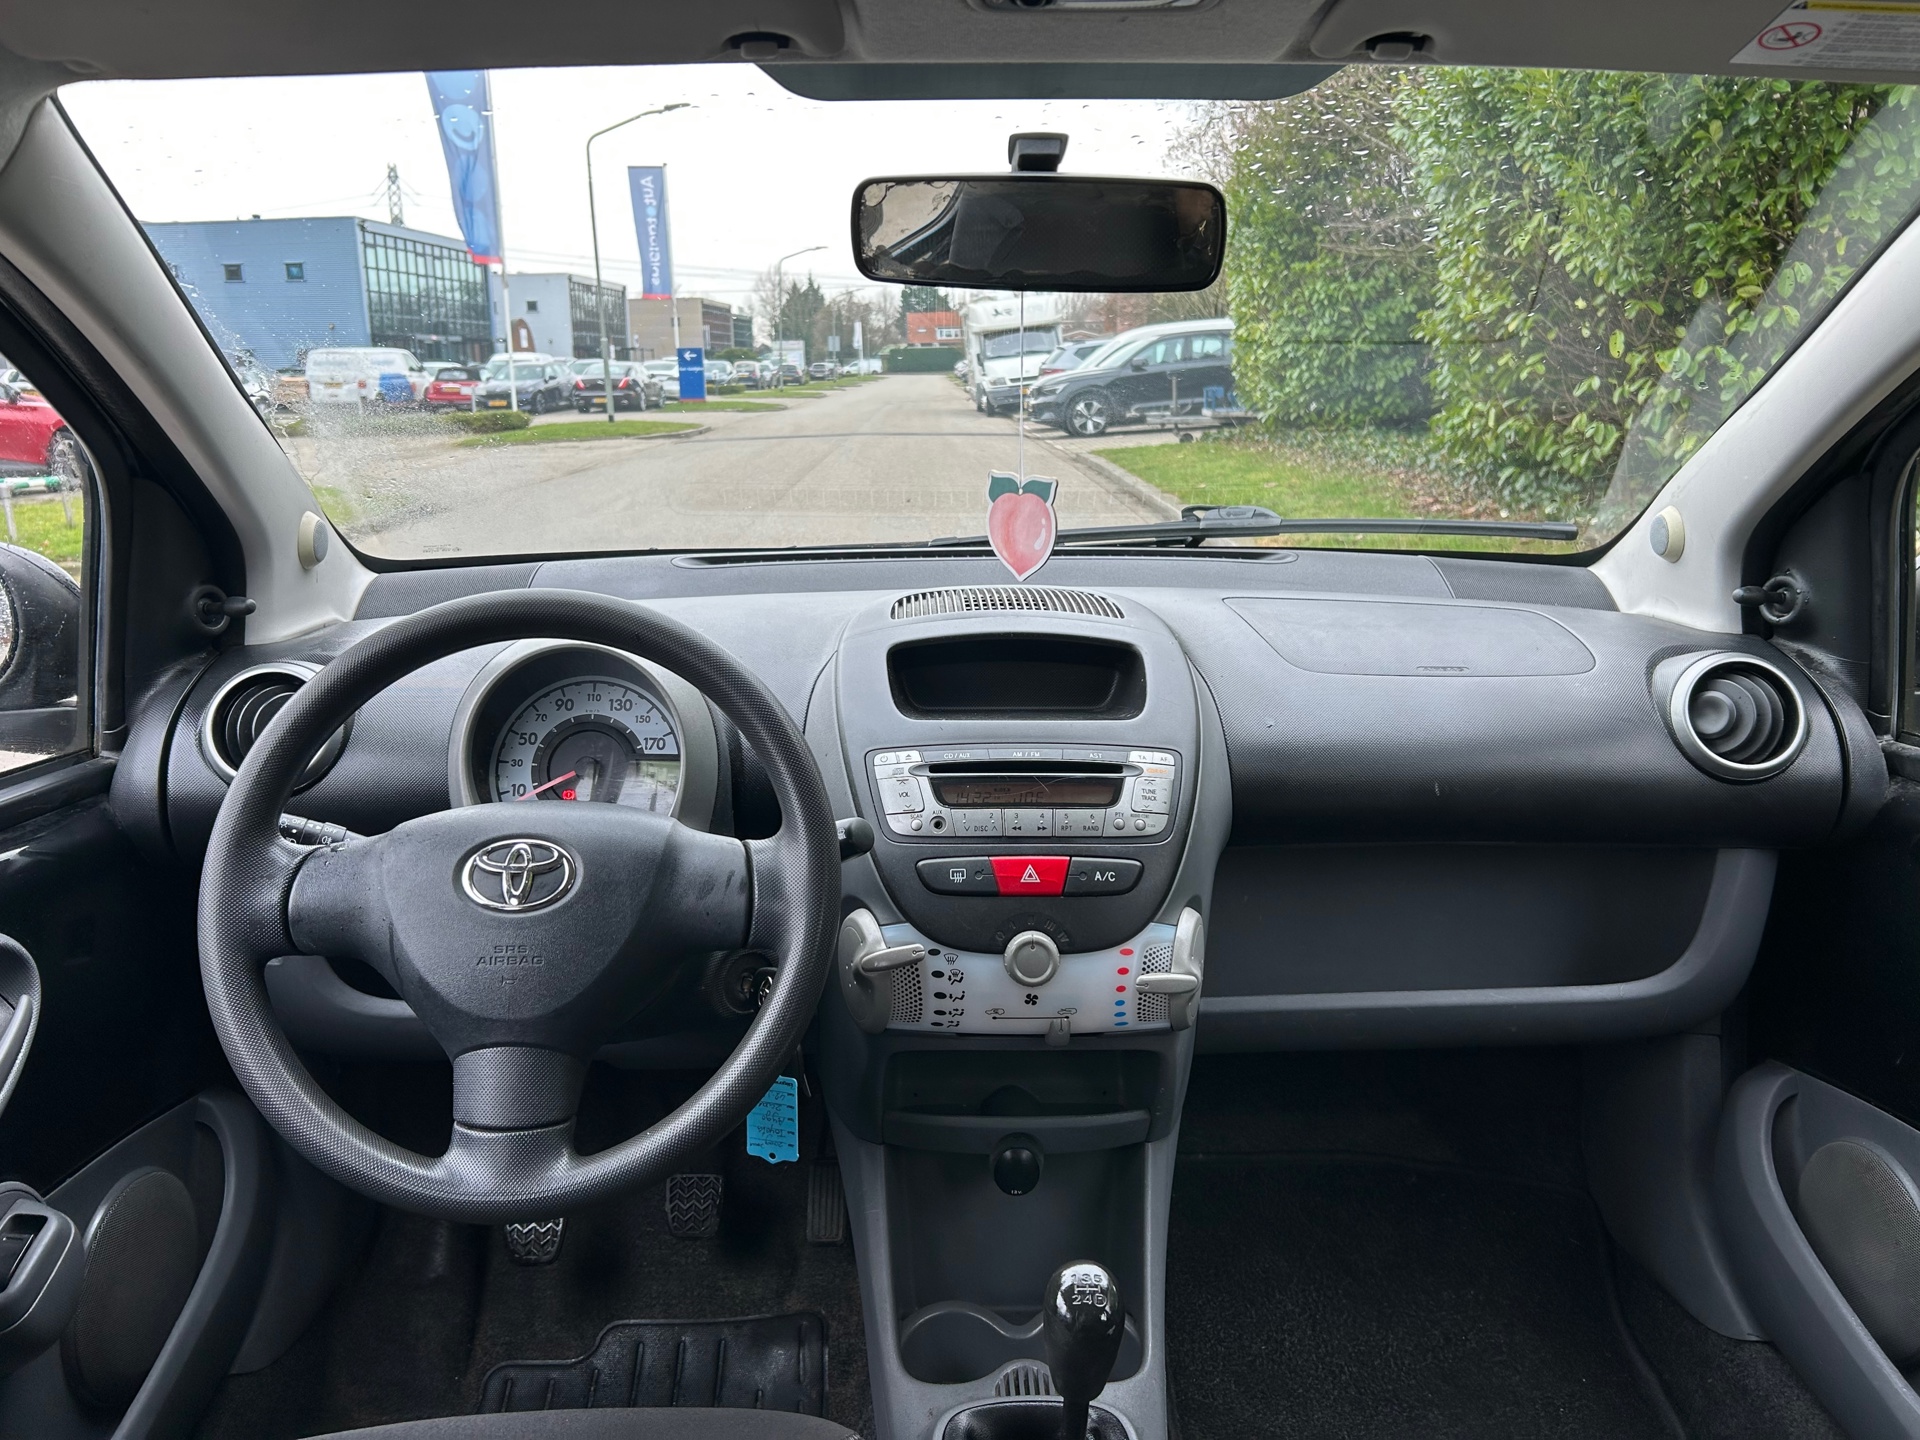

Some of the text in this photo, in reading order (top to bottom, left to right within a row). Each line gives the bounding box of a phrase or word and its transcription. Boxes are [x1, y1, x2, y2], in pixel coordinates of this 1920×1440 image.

[587, 693, 602, 702] 110
[555, 699, 574, 711] 90
[608, 698, 633, 712] 130
[534, 713, 547, 722] 70
[635, 715, 651, 723] 150
[518, 732, 538, 746] 50
[643, 737, 666, 750] 170
[510, 759, 523, 767] 30
[511, 784, 526, 796] 10
[1094, 871, 1116, 882] A/C
[494, 945, 529, 954] SRS
[476, 956, 544, 966] AIRBAG
